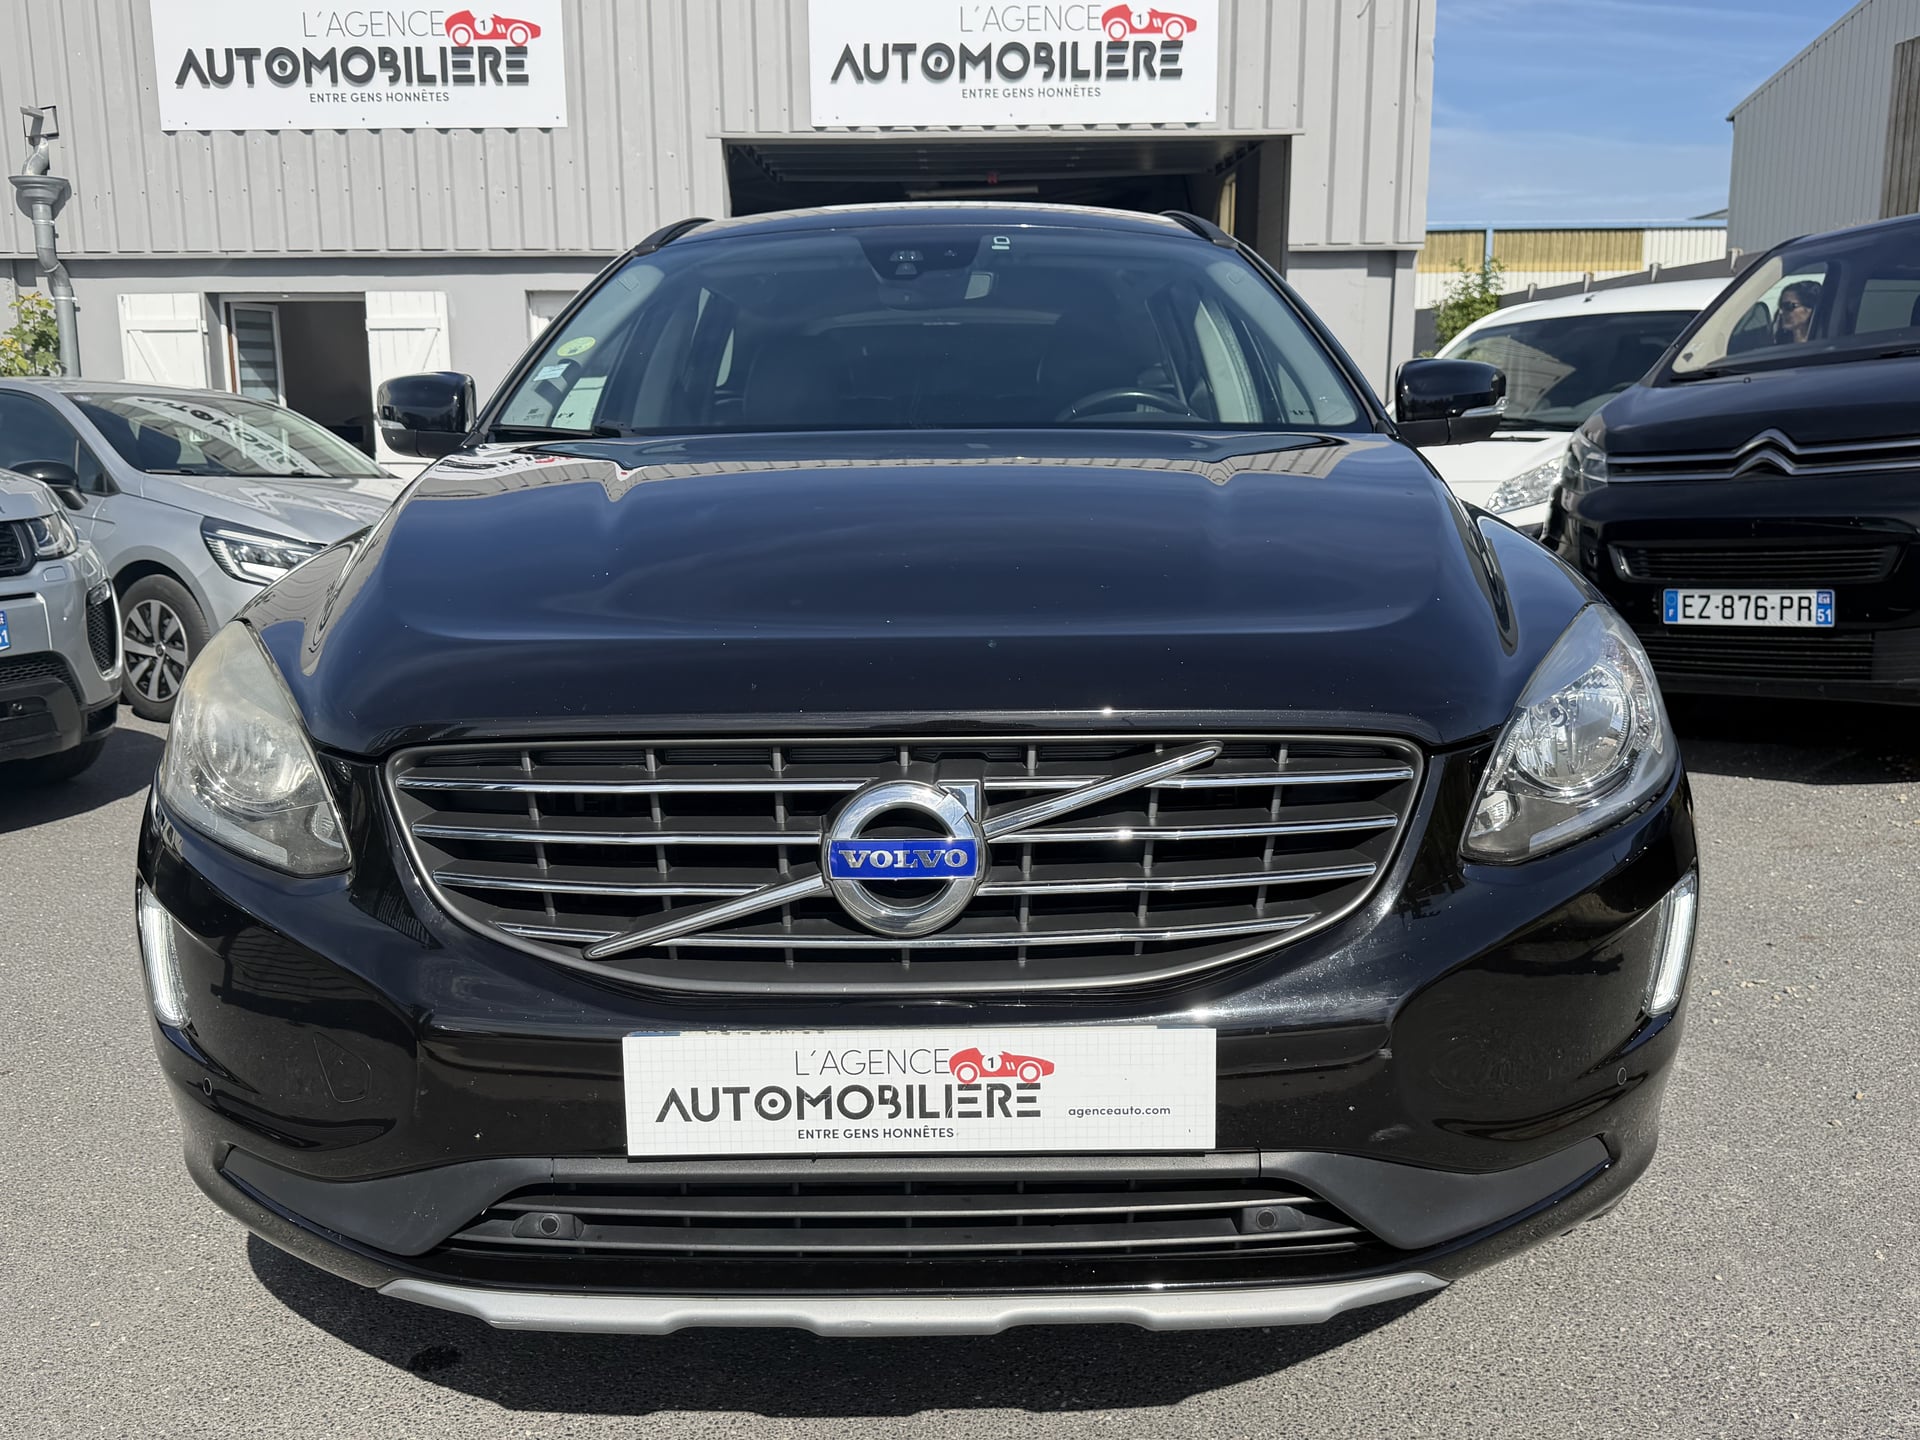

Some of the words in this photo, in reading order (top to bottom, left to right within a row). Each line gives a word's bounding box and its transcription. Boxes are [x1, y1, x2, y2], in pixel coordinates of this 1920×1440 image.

[309, 93, 347, 103] ENTRE
[350, 92, 383, 103] GENS
[385, 89, 449, 102] HONNÊTES
[962, 88, 999, 99] ENTRE
[1002, 88, 1034, 98] GENS
[1037, 84, 1101, 97] HONNÊTES
[1682, 595, 1812, 621] EZ-876-PR
[1816, 609, 1832, 622] 51
[839, 849, 968, 869] VOLVO
[1068, 1105, 1171, 1116] agenceauto.com
[798, 1129, 839, 1139] ENTRE
[843, 1128, 879, 1138] GENS
[883, 1124, 954, 1138] HONNÊTES
